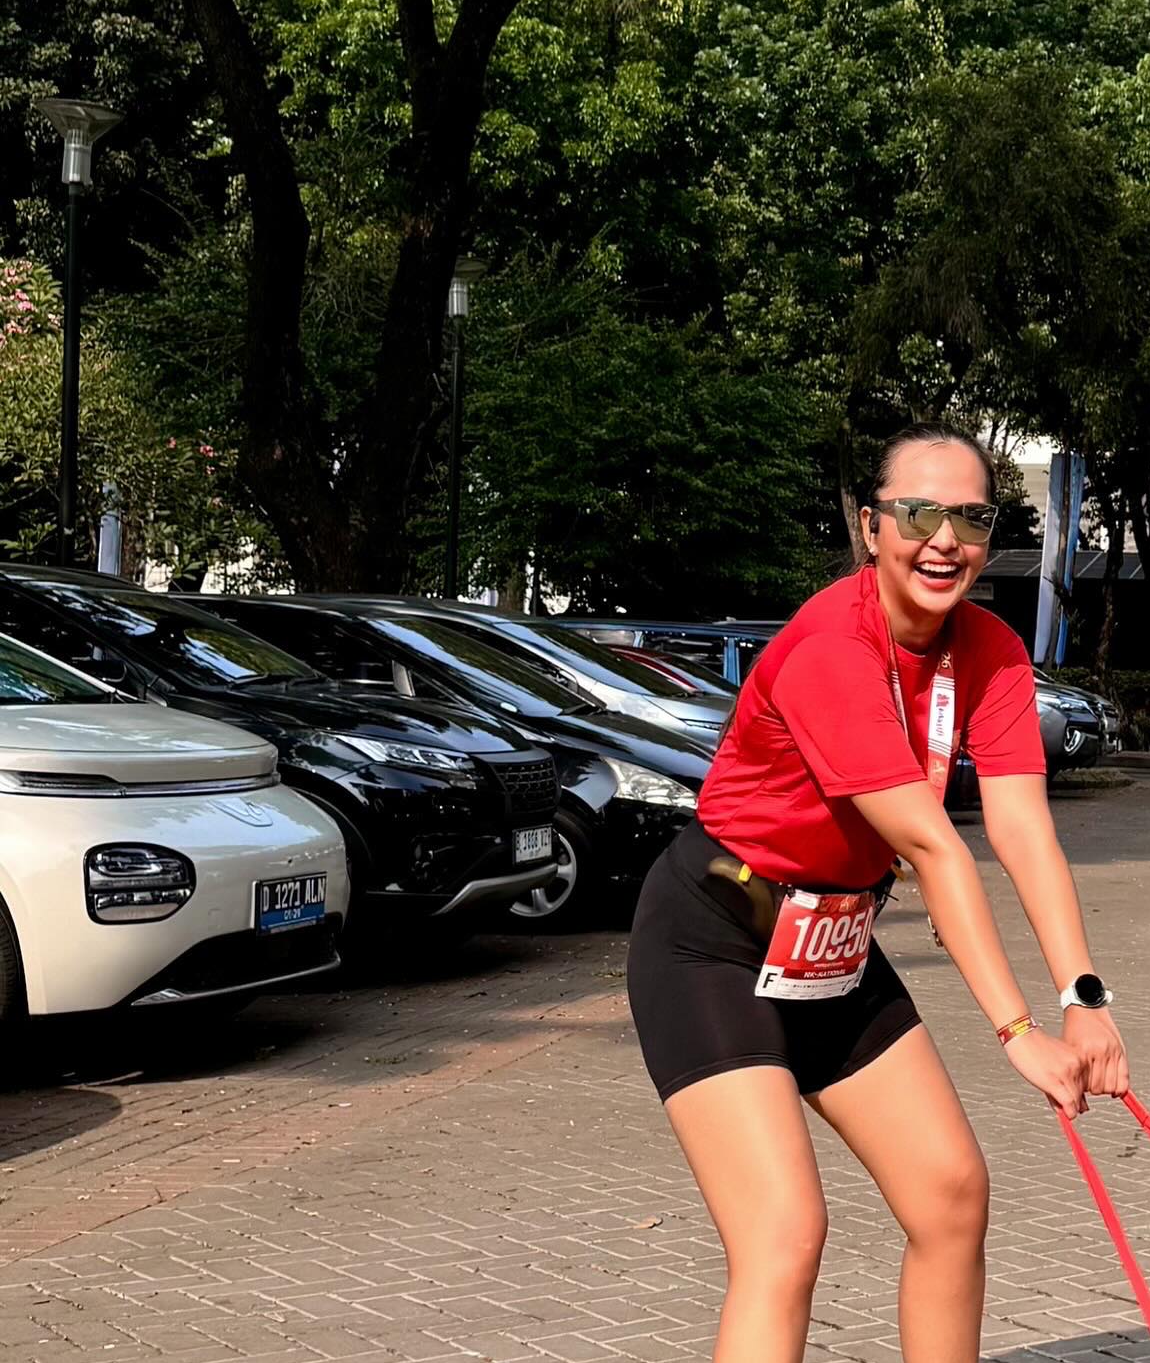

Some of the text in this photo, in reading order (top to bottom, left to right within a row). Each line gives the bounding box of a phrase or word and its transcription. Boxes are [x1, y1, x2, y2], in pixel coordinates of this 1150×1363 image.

[263, 878, 325, 912] D 1271 ALN
[791, 906, 873, 962] 10950
[762, 972, 778, 989] F
